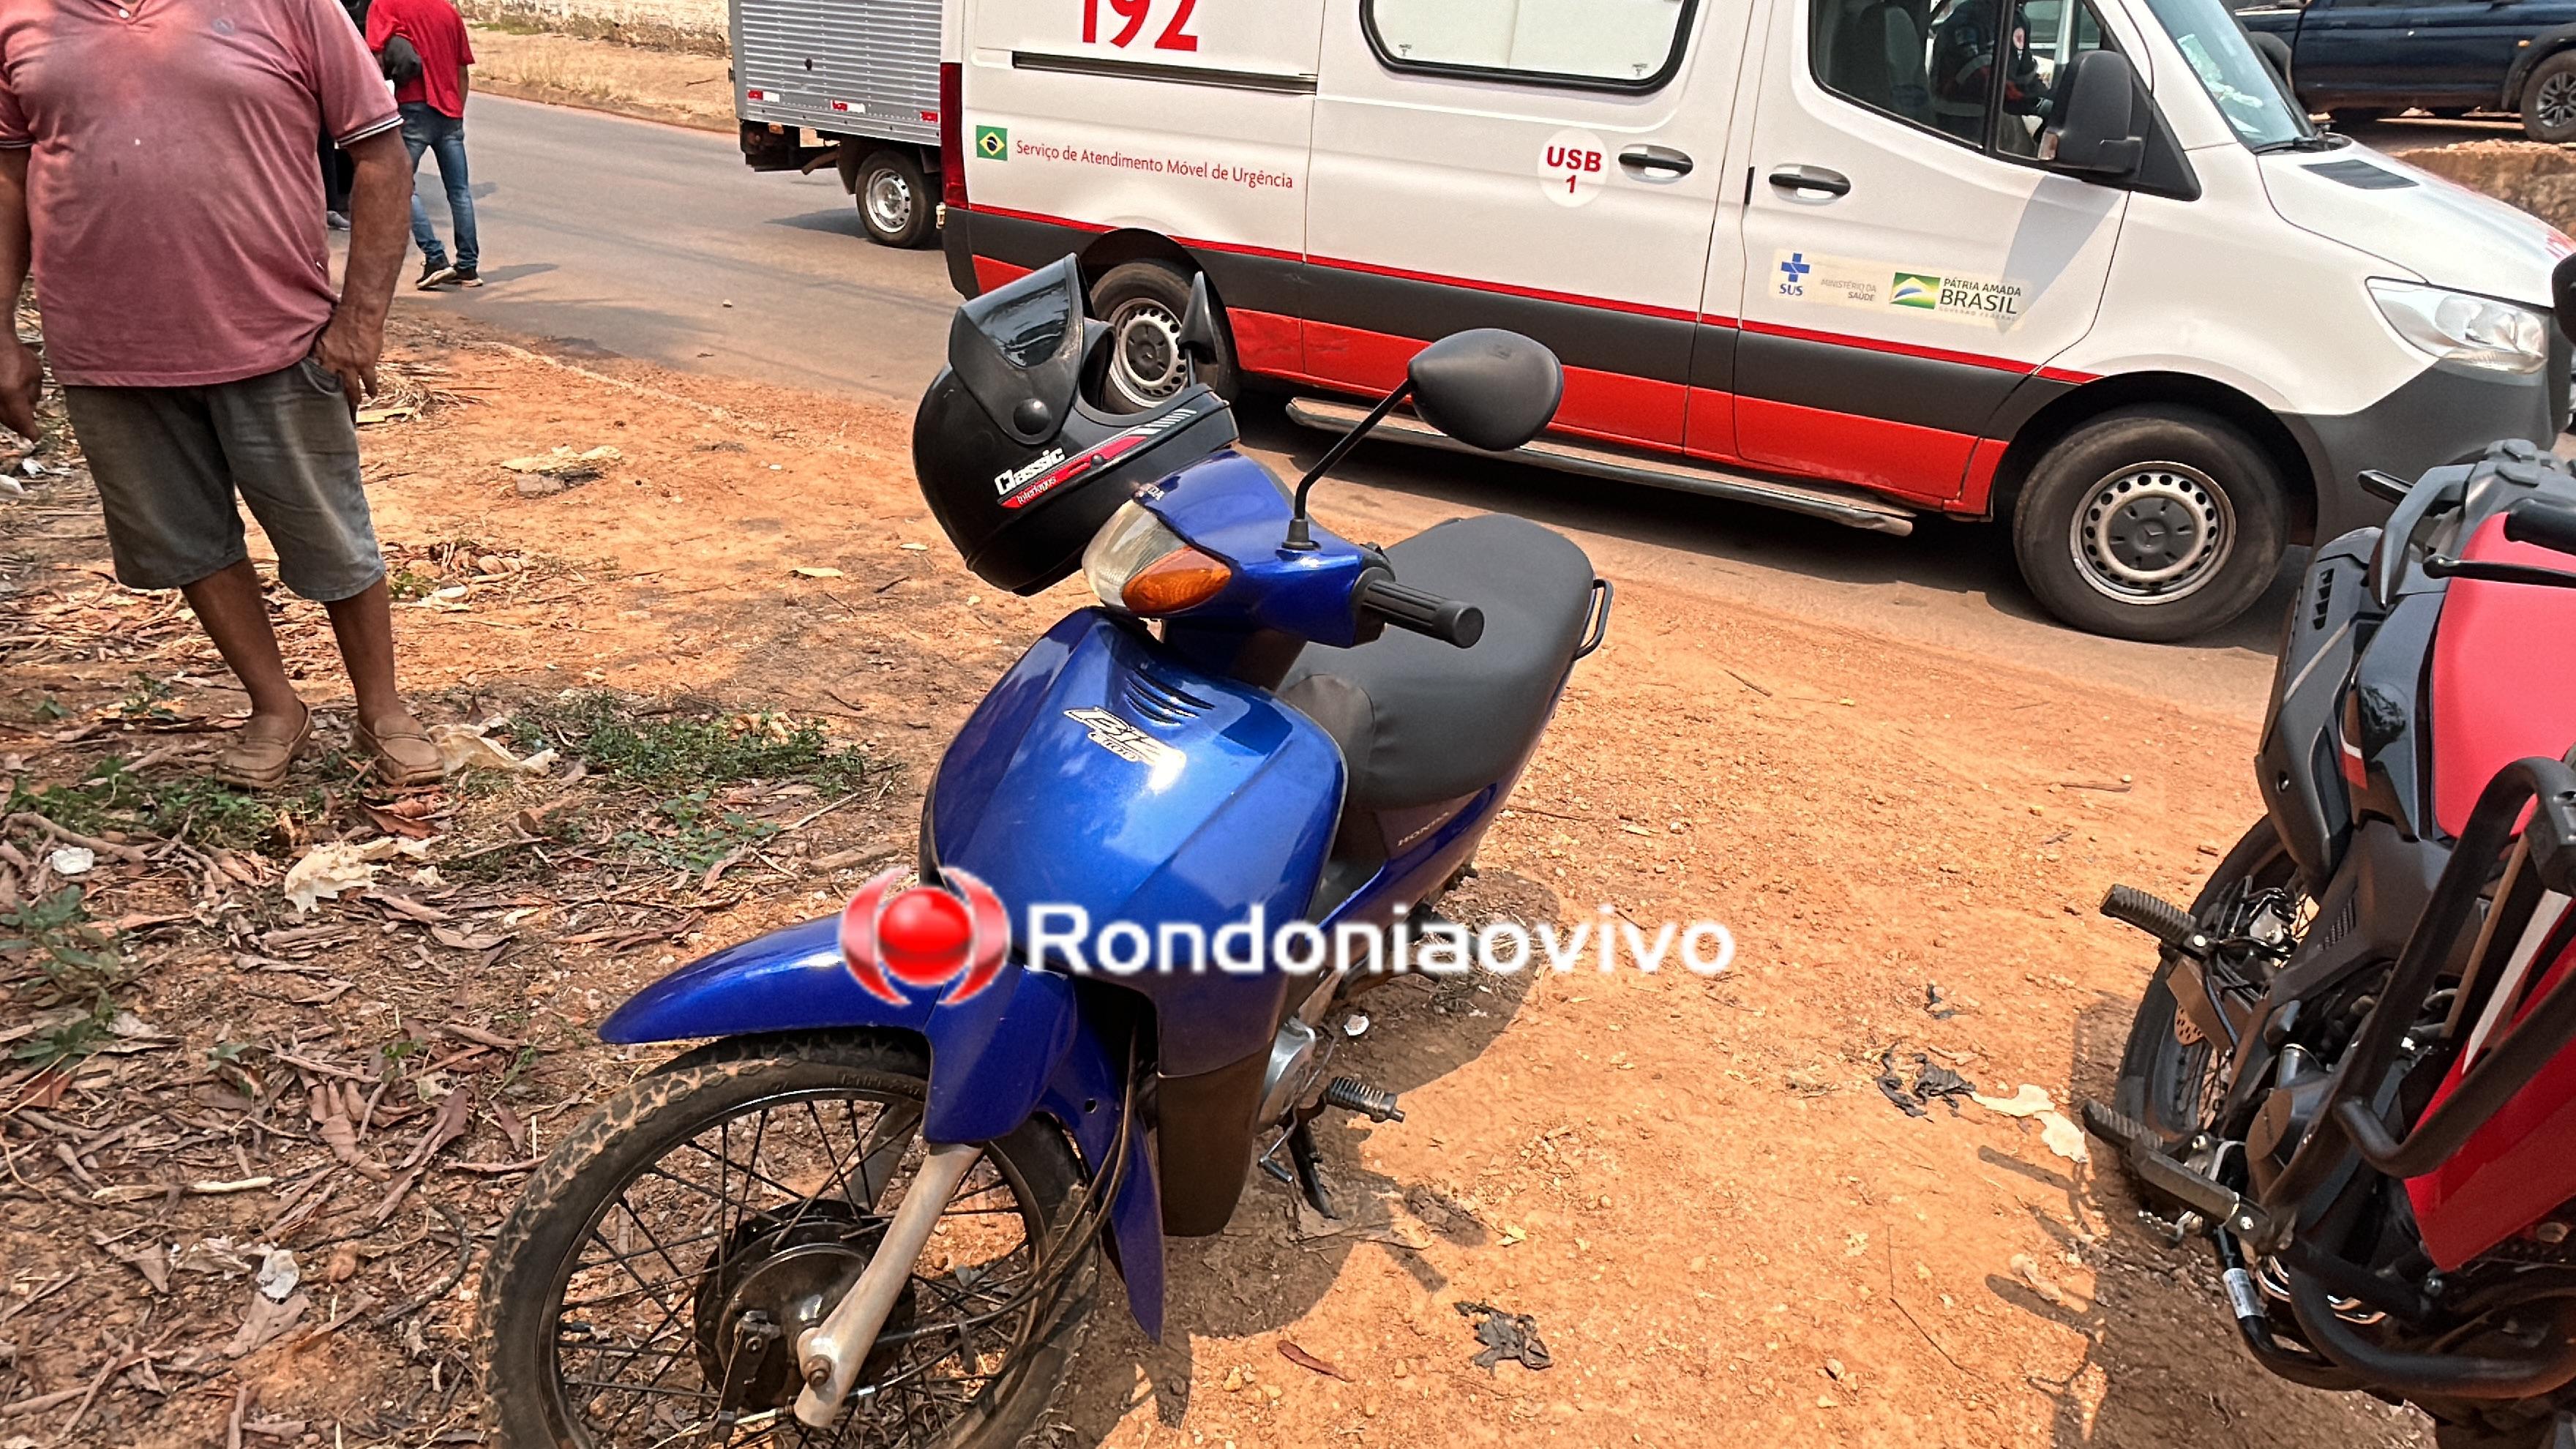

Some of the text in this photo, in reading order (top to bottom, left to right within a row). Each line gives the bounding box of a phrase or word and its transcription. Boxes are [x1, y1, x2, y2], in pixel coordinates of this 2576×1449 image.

[1082, 0, 1198, 52] 192
[1016, 140, 1293, 188] Serviço de Atendimento Móvel de Urgência
[1546, 146, 1603, 173] USB
[1565, 175, 1577, 194] 1
[1779, 283, 1803, 296] SUS
[1944, 277, 2021, 296] PÁTRIA AMADA
[1940, 288, 2017, 315] BRASIL
[995, 447, 1066, 495] Classic
